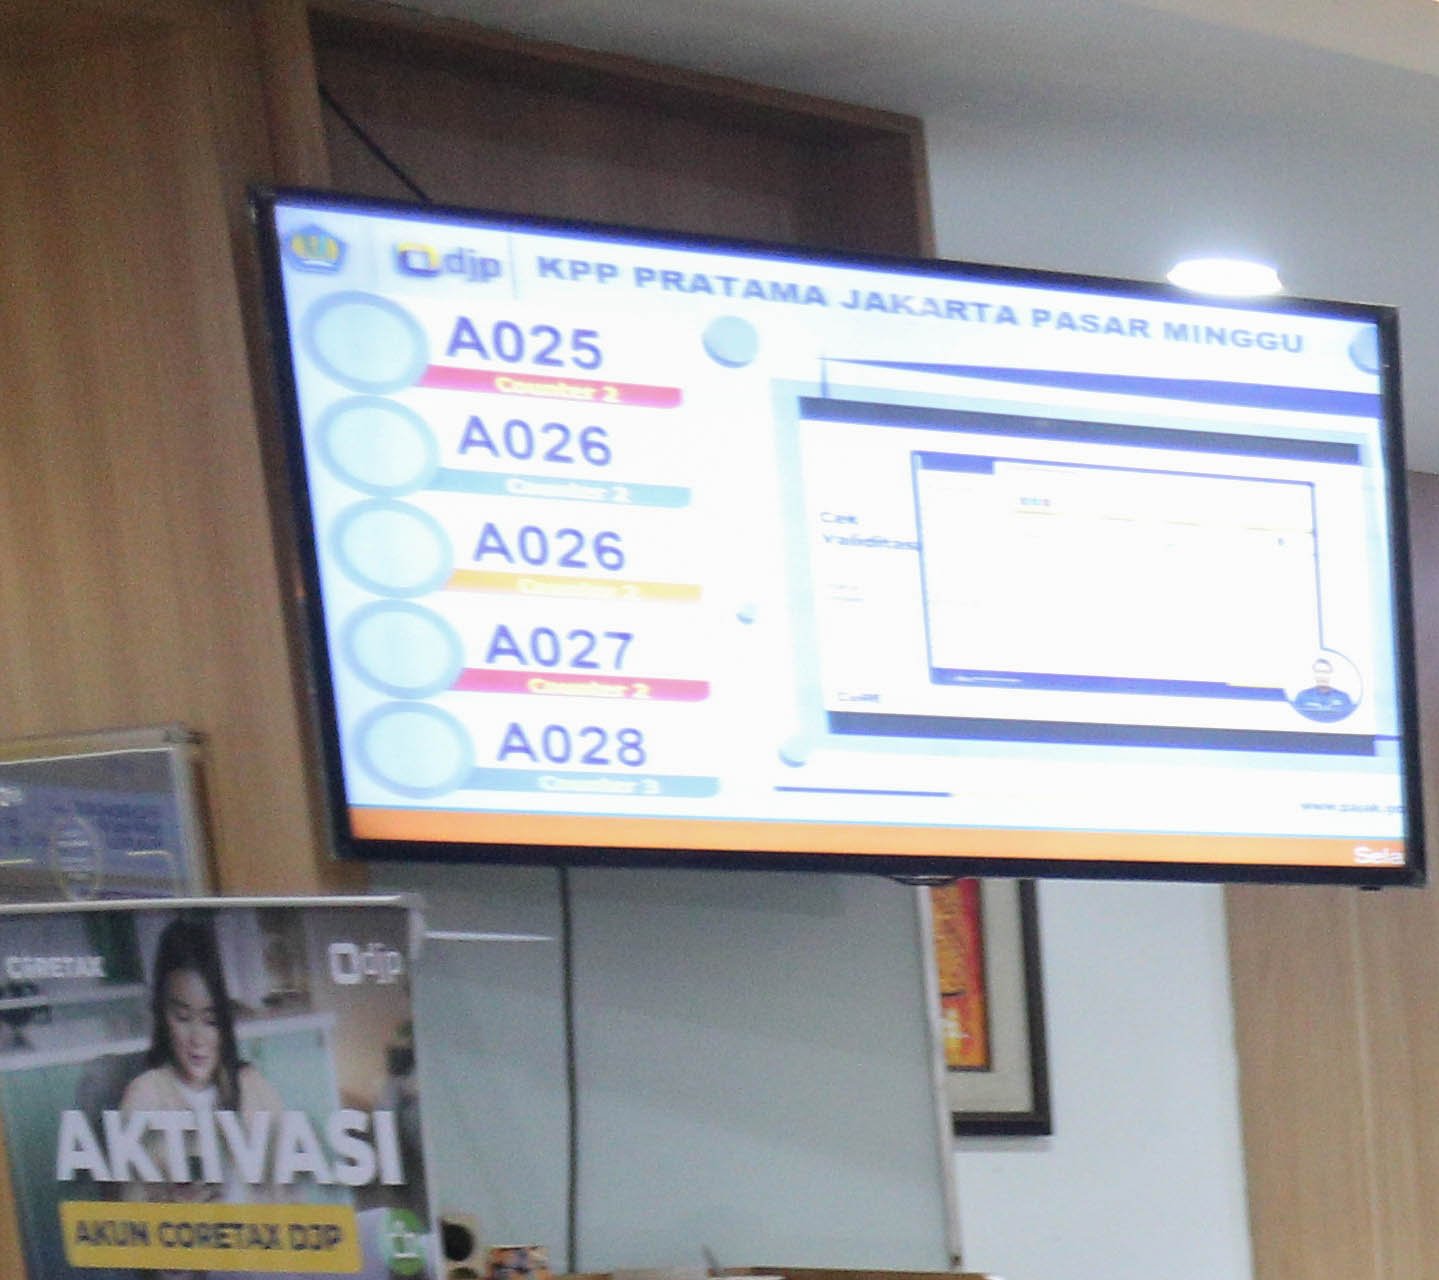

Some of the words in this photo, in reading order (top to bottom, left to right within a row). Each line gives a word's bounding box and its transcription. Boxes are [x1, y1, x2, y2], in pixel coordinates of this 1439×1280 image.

[443, 247, 502, 283] djp
[537, 256, 619, 284] KPP
[634, 266, 828, 307] PRATAMA
[839, 288, 1020, 326] JAKARTA
[1031, 308, 1151, 338] PASAR
[1164, 321, 1305, 354] MINGGU
[445, 316, 604, 371] A025
[457, 415, 613, 467] A026
[473, 522, 626, 571] A026
[485, 624, 635, 671] A027
[496, 721, 648, 768] A028
[56, 1108, 405, 1187] AKTIVASI
[75, 1219, 151, 1247] AKUN
[158, 1220, 281, 1250] CORETAX
